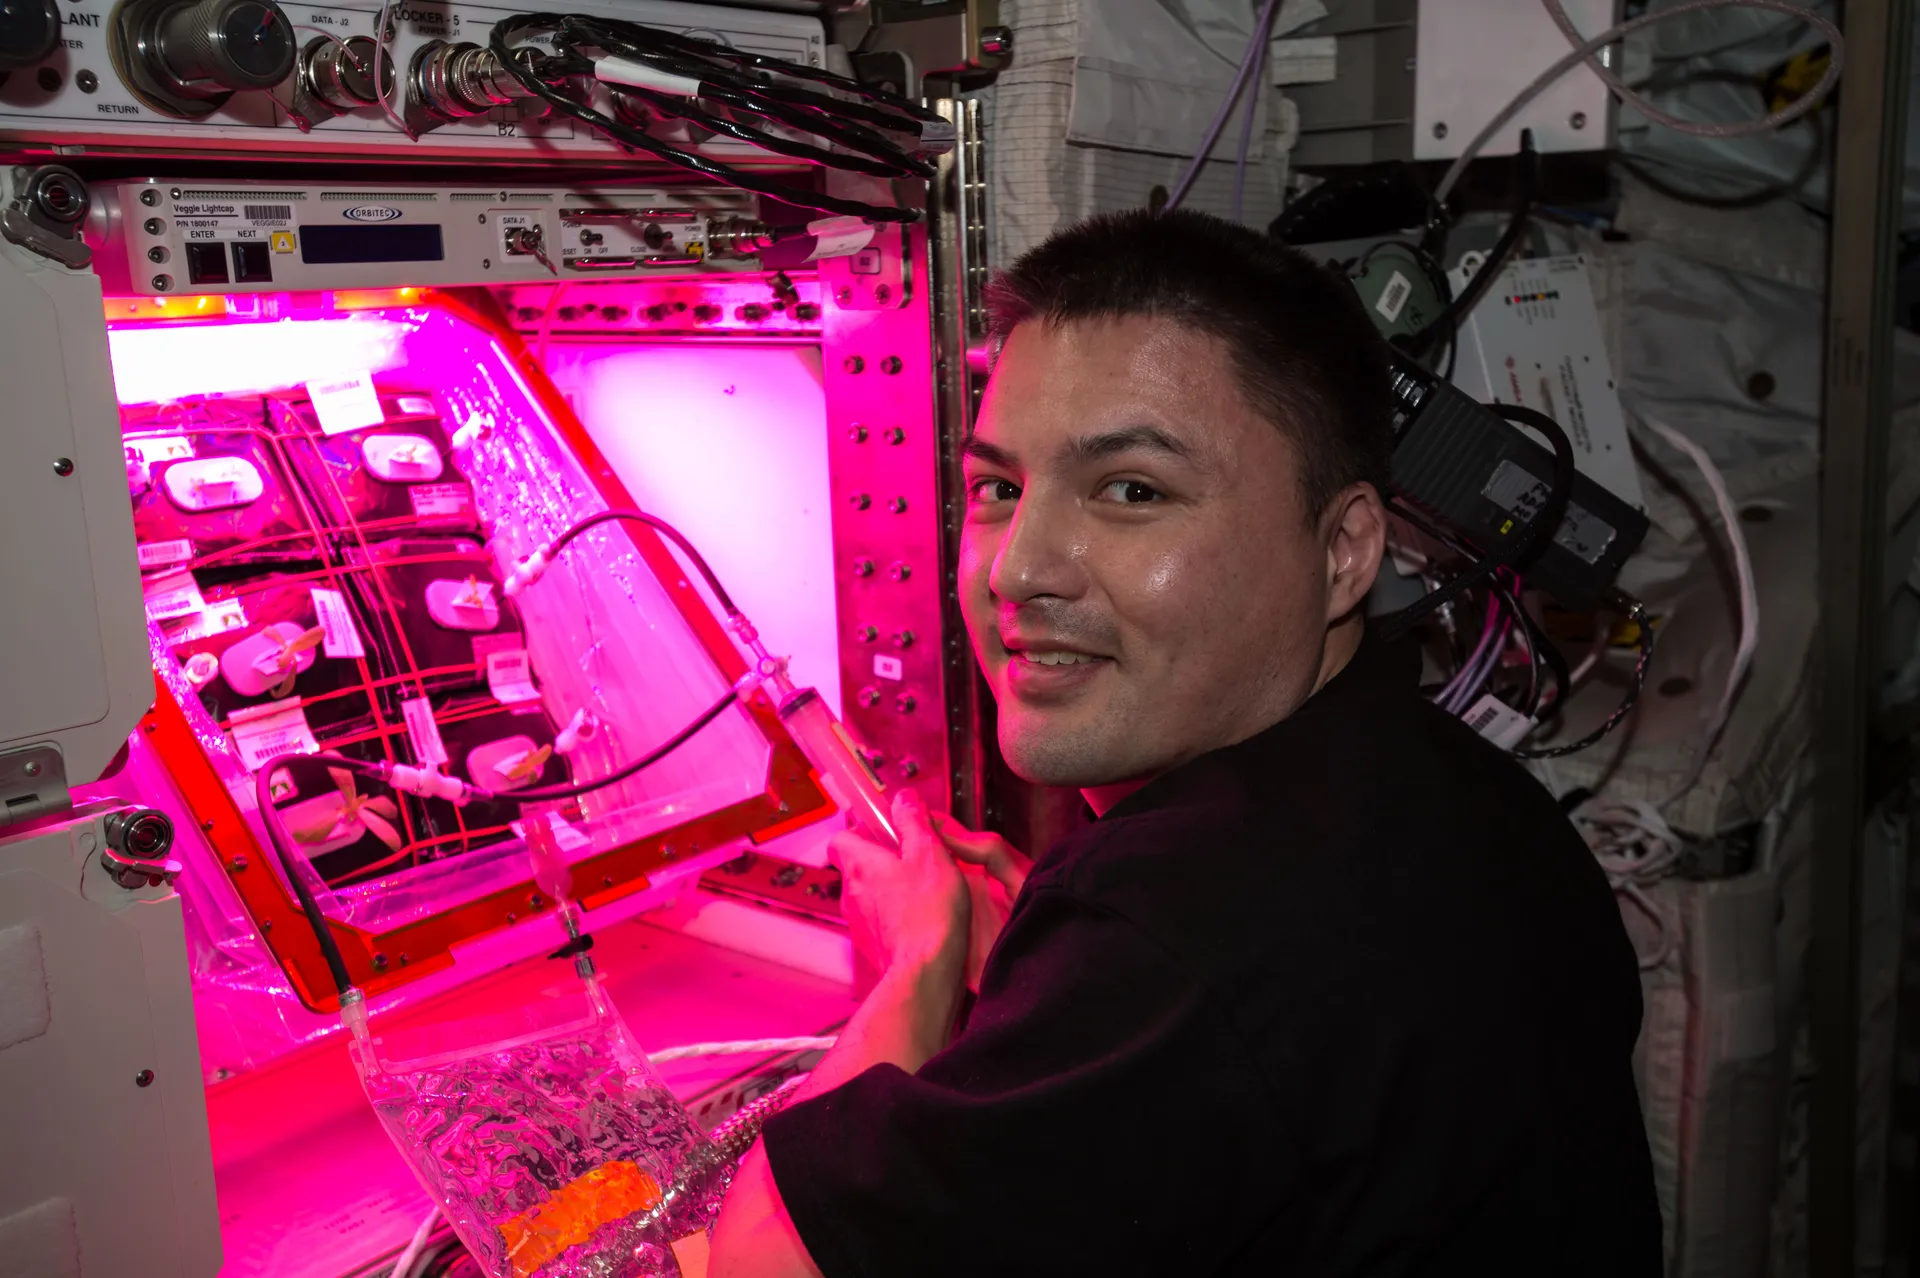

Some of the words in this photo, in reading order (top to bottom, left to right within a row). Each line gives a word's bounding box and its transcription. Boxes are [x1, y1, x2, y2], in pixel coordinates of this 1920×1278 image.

[312, 15, 333, 25] DATA
[340, 18, 349, 26] J2
[394, 8, 444, 25] LOCKER
[453, 15, 460, 26] 5
[418, 26, 447, 36] POWER
[525, 35, 551, 44] POWER
[97, 104, 139, 115] RETURN
[498, 124, 516, 137] B2
[173, 204, 200, 214] Veggie
[201, 204, 235, 214] Lightcap
[356, 209, 389, 217] ORBITEC
[176, 220, 189, 228] P/N
[190, 220, 219, 228] 1800147
[502, 217, 518, 225] DATA
[190, 230, 216, 239] ENTER
[237, 230, 257, 238] NEXT
